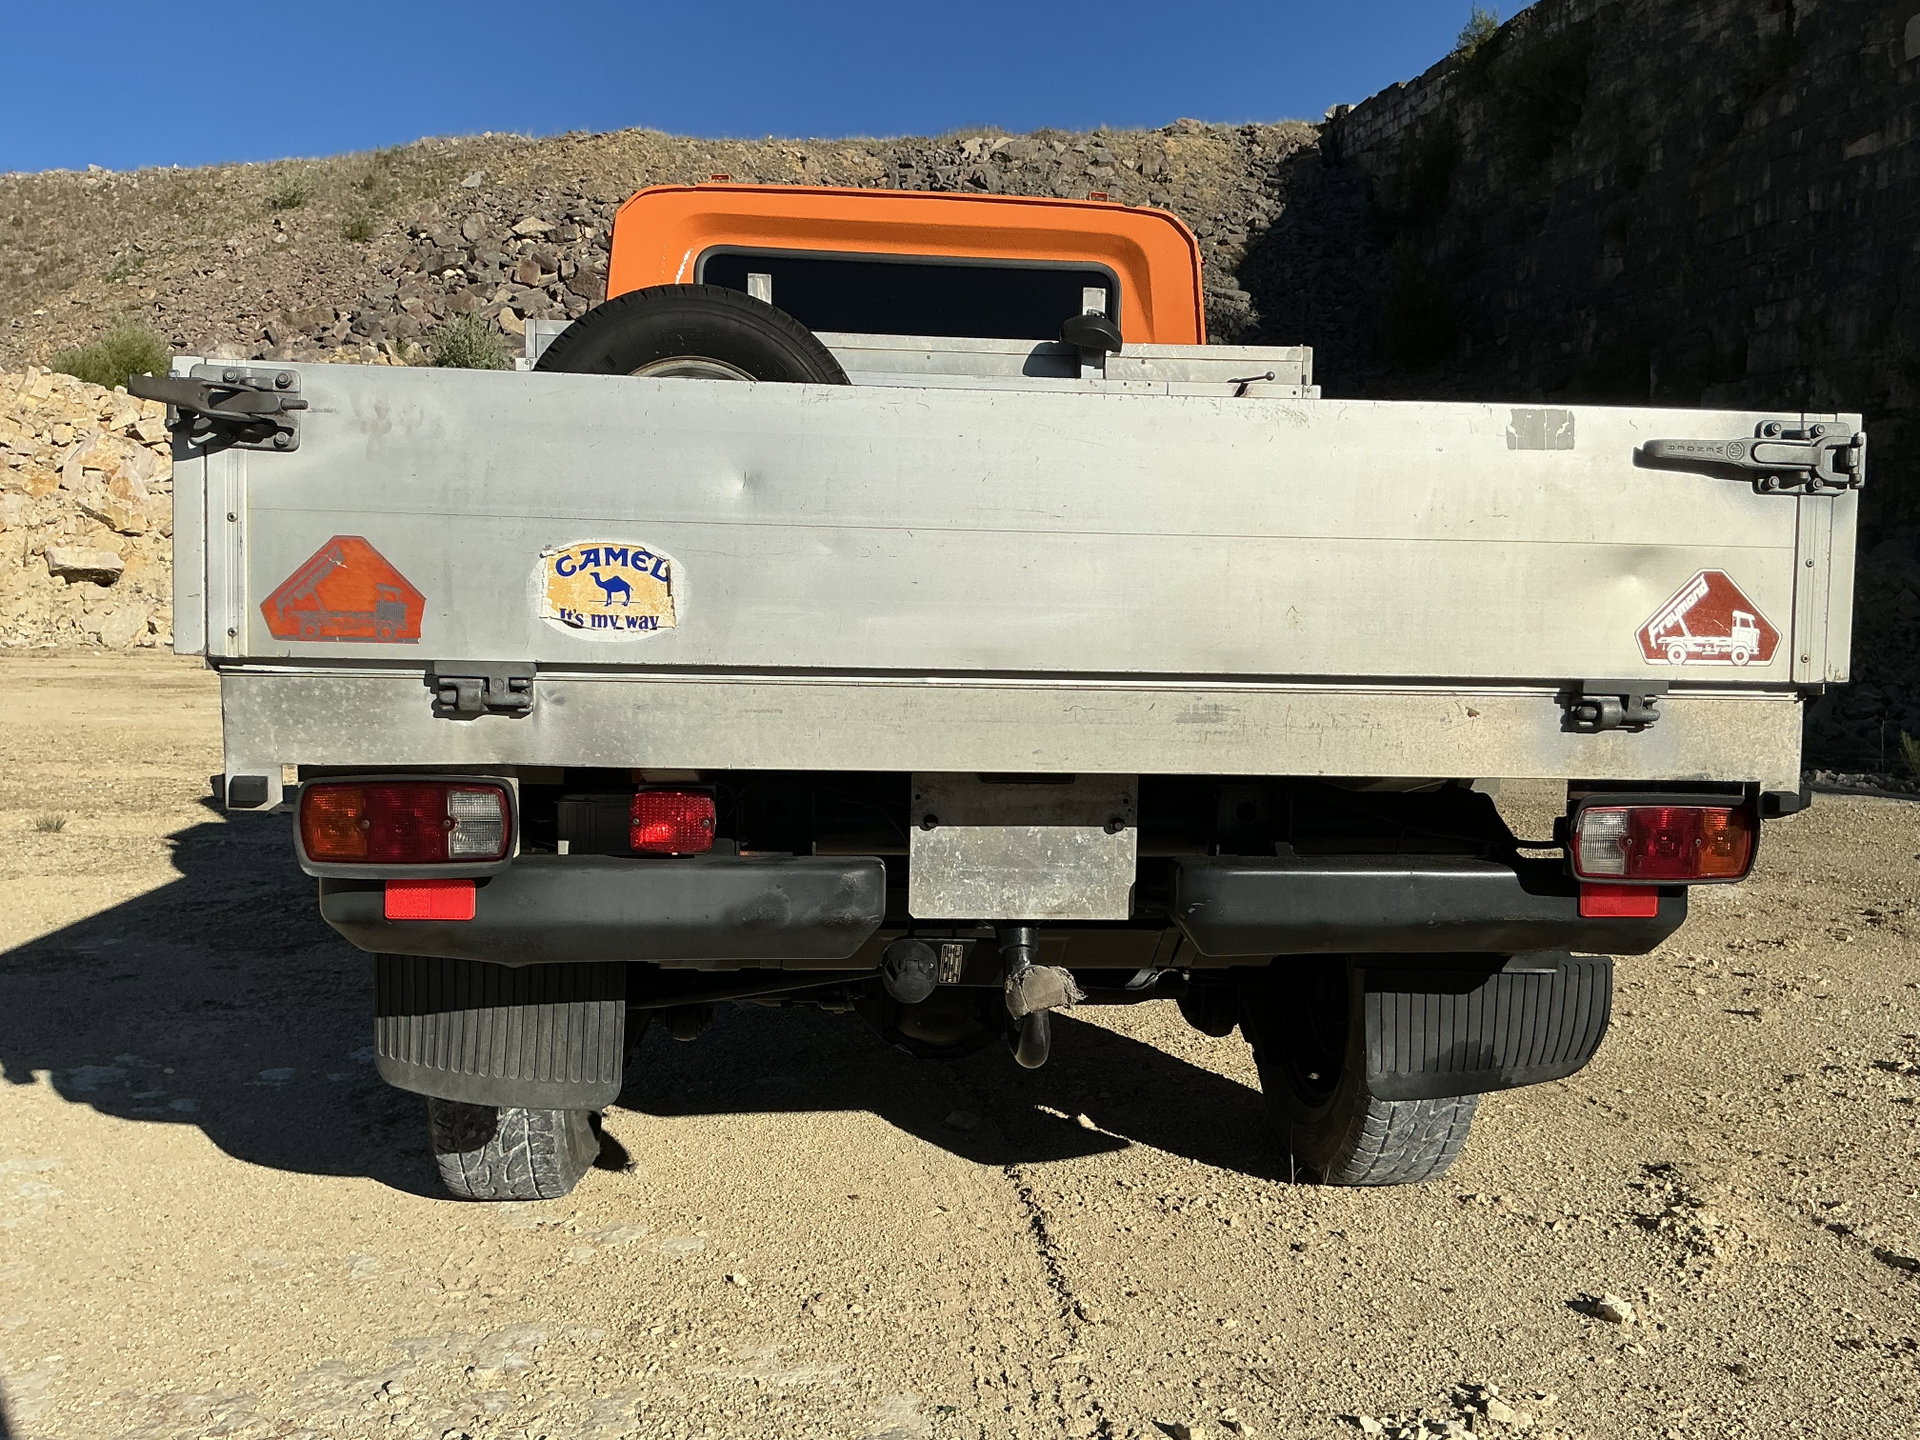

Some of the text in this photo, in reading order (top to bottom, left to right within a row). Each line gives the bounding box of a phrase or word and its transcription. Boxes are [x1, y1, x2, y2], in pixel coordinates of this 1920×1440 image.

[555, 547, 669, 582] CAMEL
[559, 608, 660, 630] It's my way
